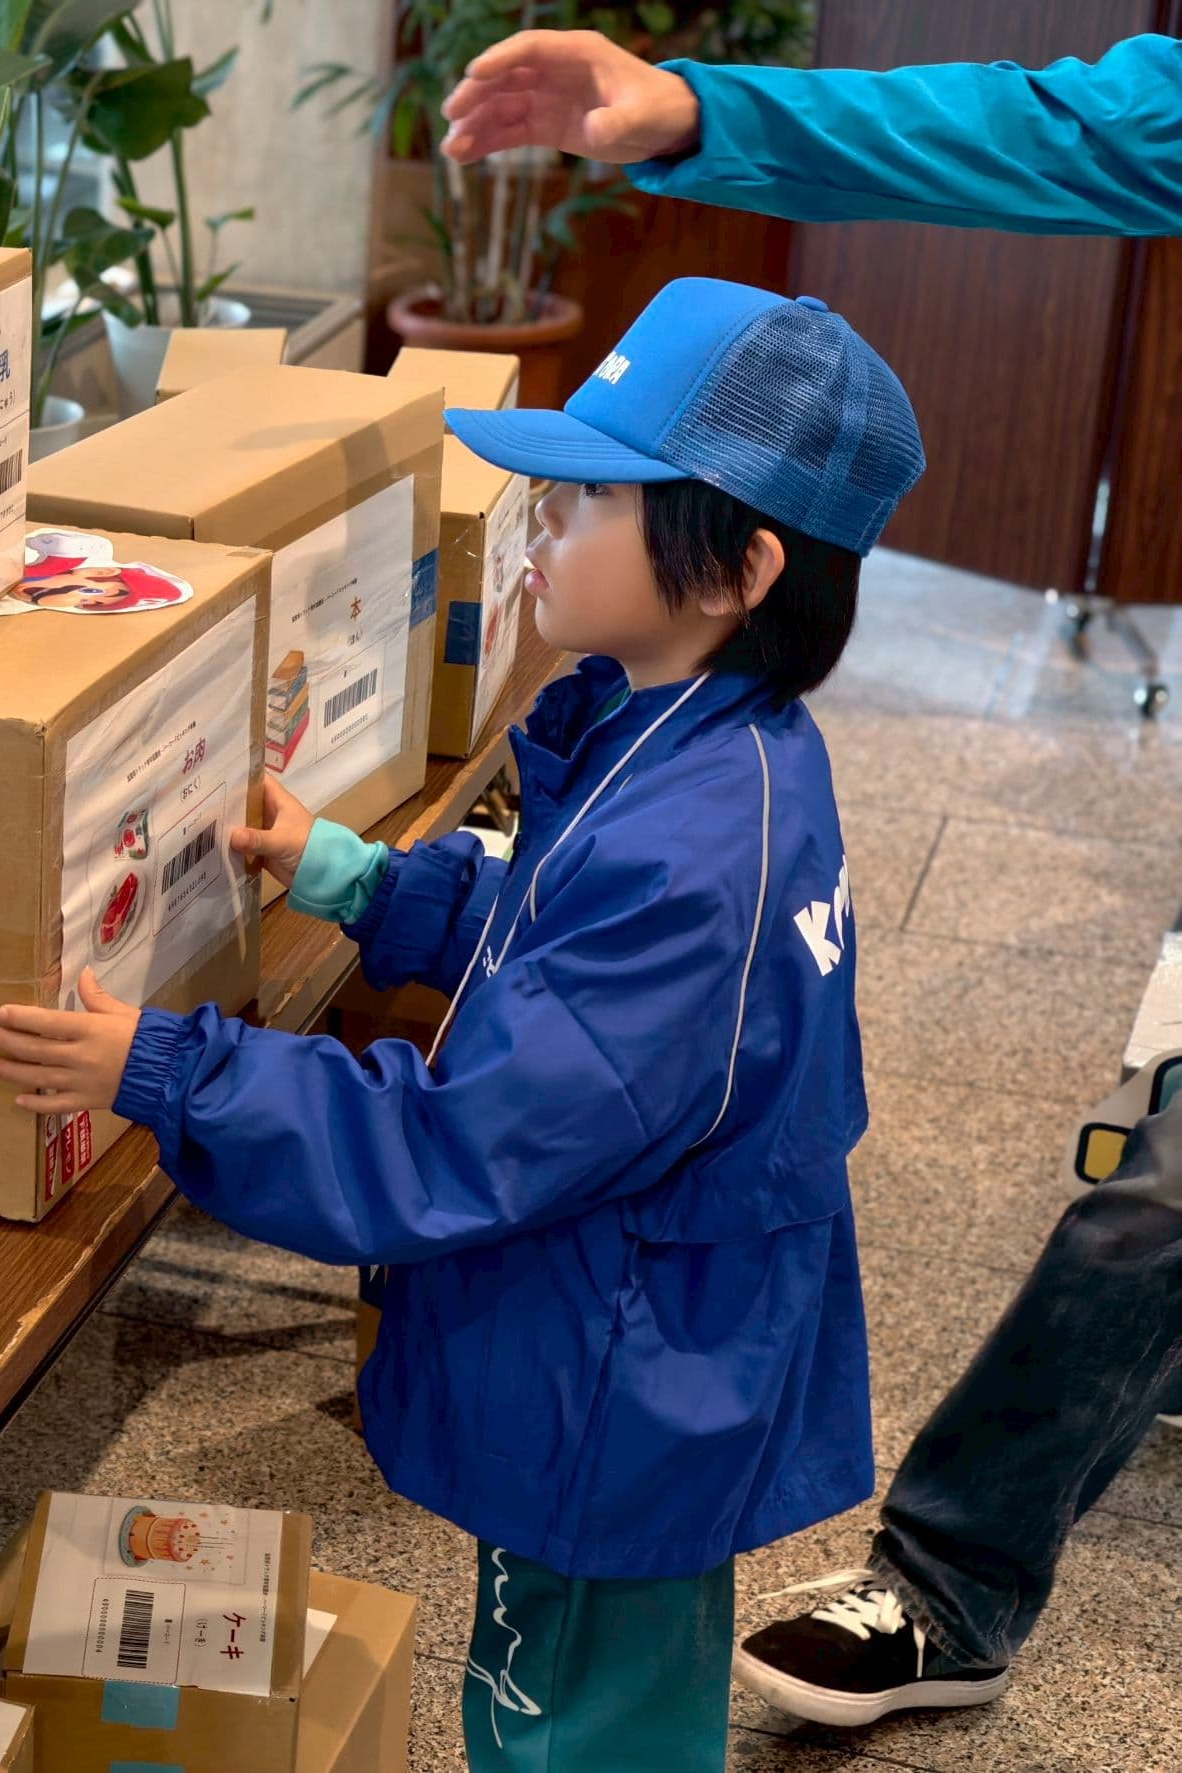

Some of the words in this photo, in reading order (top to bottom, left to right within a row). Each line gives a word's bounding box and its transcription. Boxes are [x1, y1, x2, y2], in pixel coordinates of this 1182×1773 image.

[350, 596, 361, 622] 本
[183, 737, 206, 774] お肉
[220, 1612, 246, 1660] ケーキ
